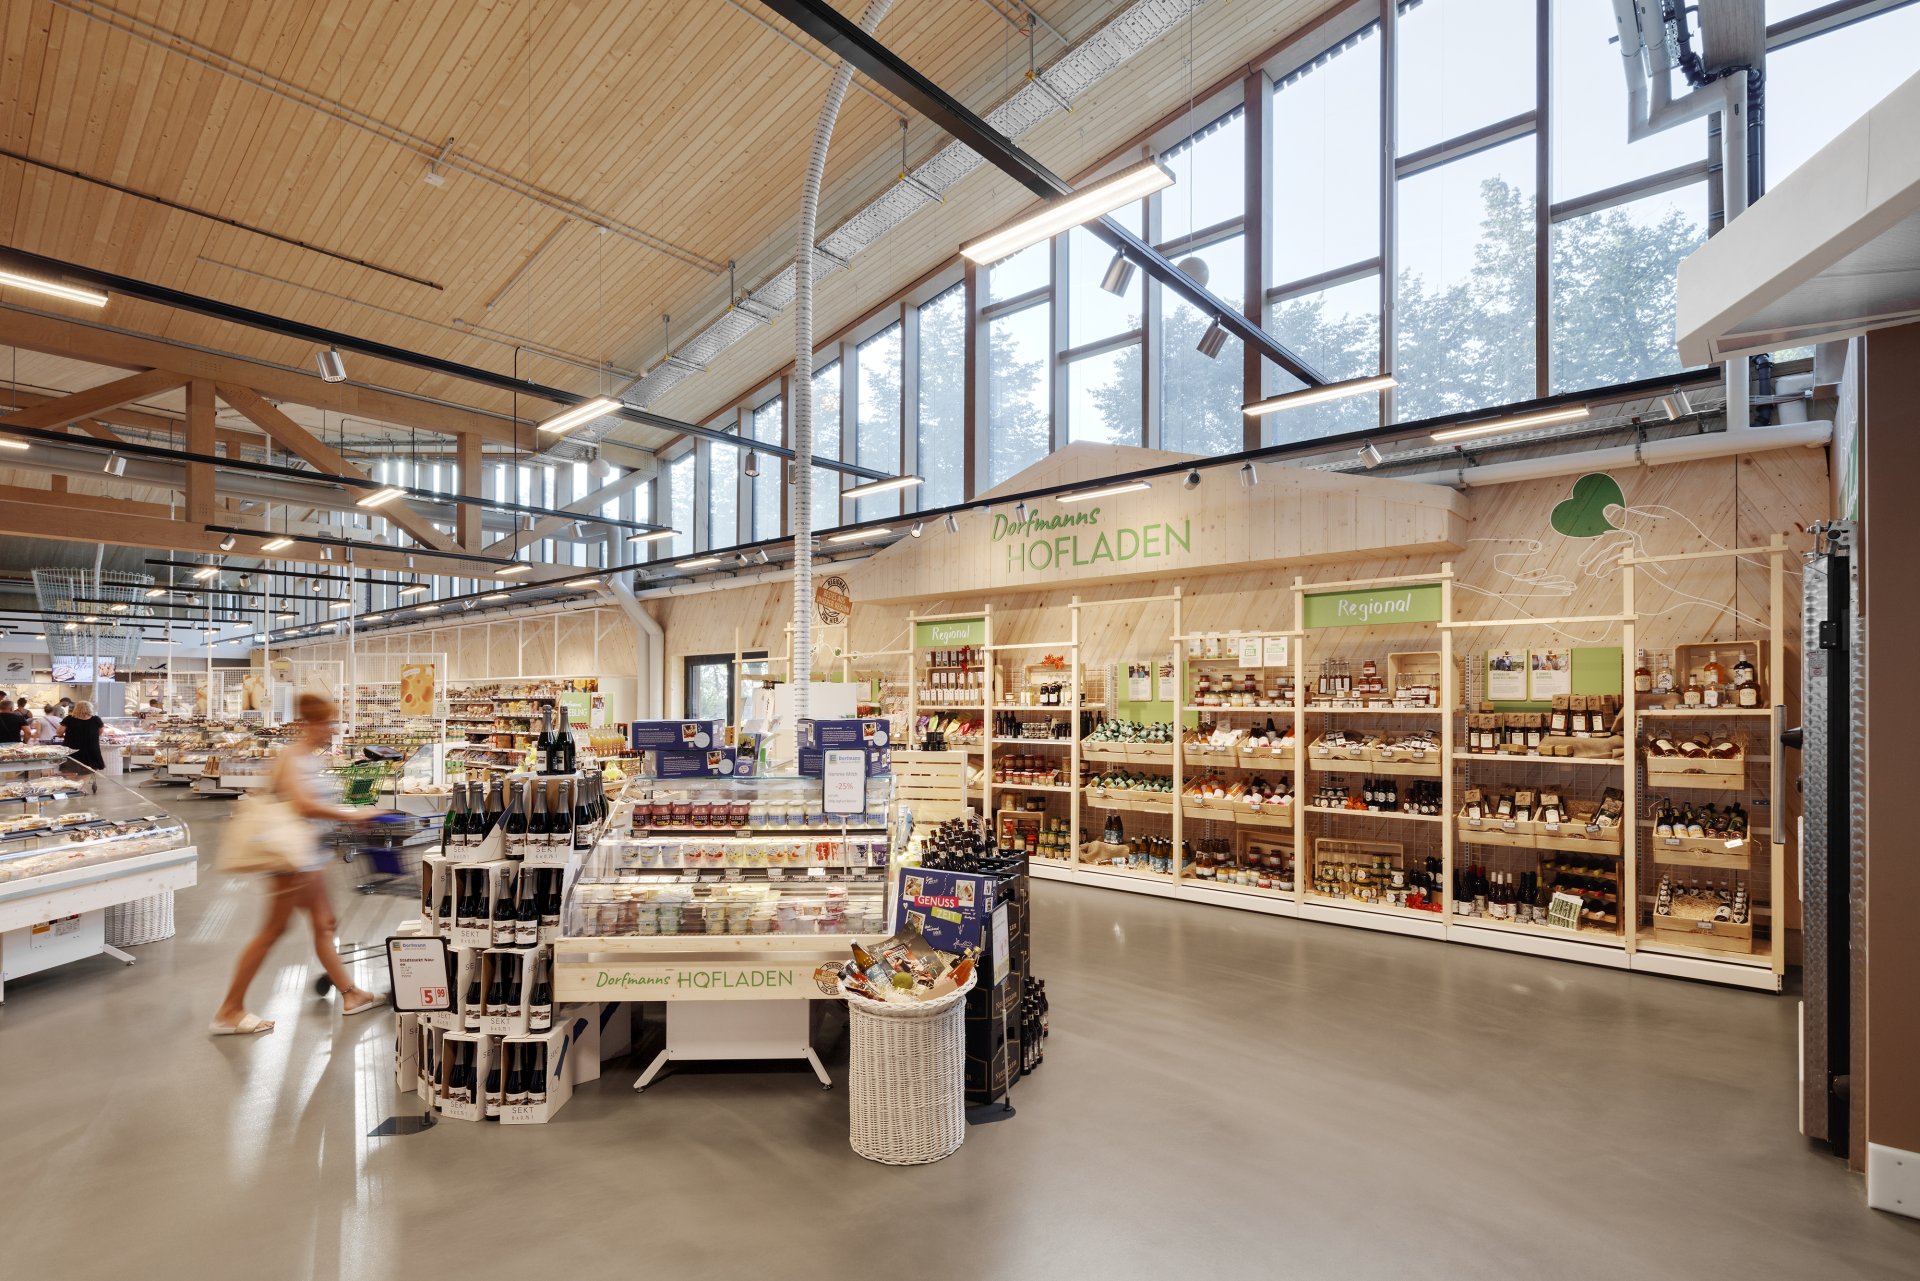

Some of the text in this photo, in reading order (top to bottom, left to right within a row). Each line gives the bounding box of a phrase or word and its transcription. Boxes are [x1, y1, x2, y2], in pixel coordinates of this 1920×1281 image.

[990, 506, 1102, 543] Dorfmanns
[1007, 519, 1192, 575] HOFLADEN
[1337, 591, 1411, 622] Regional
[931, 624, 970, 645] Regional
[835, 782, 854, 791] -25%
[917, 895, 956, 909] GENUSS
[936, 908, 957, 921] ZEIT
[596, 970, 793, 988] Dorfmanns HOFLADEN
[424, 988, 446, 1004] 5 99
[437, 1012, 451, 1020] SEKT
[450, 1101, 467, 1109] SEKT
[512, 1106, 534, 1114] SEKT
